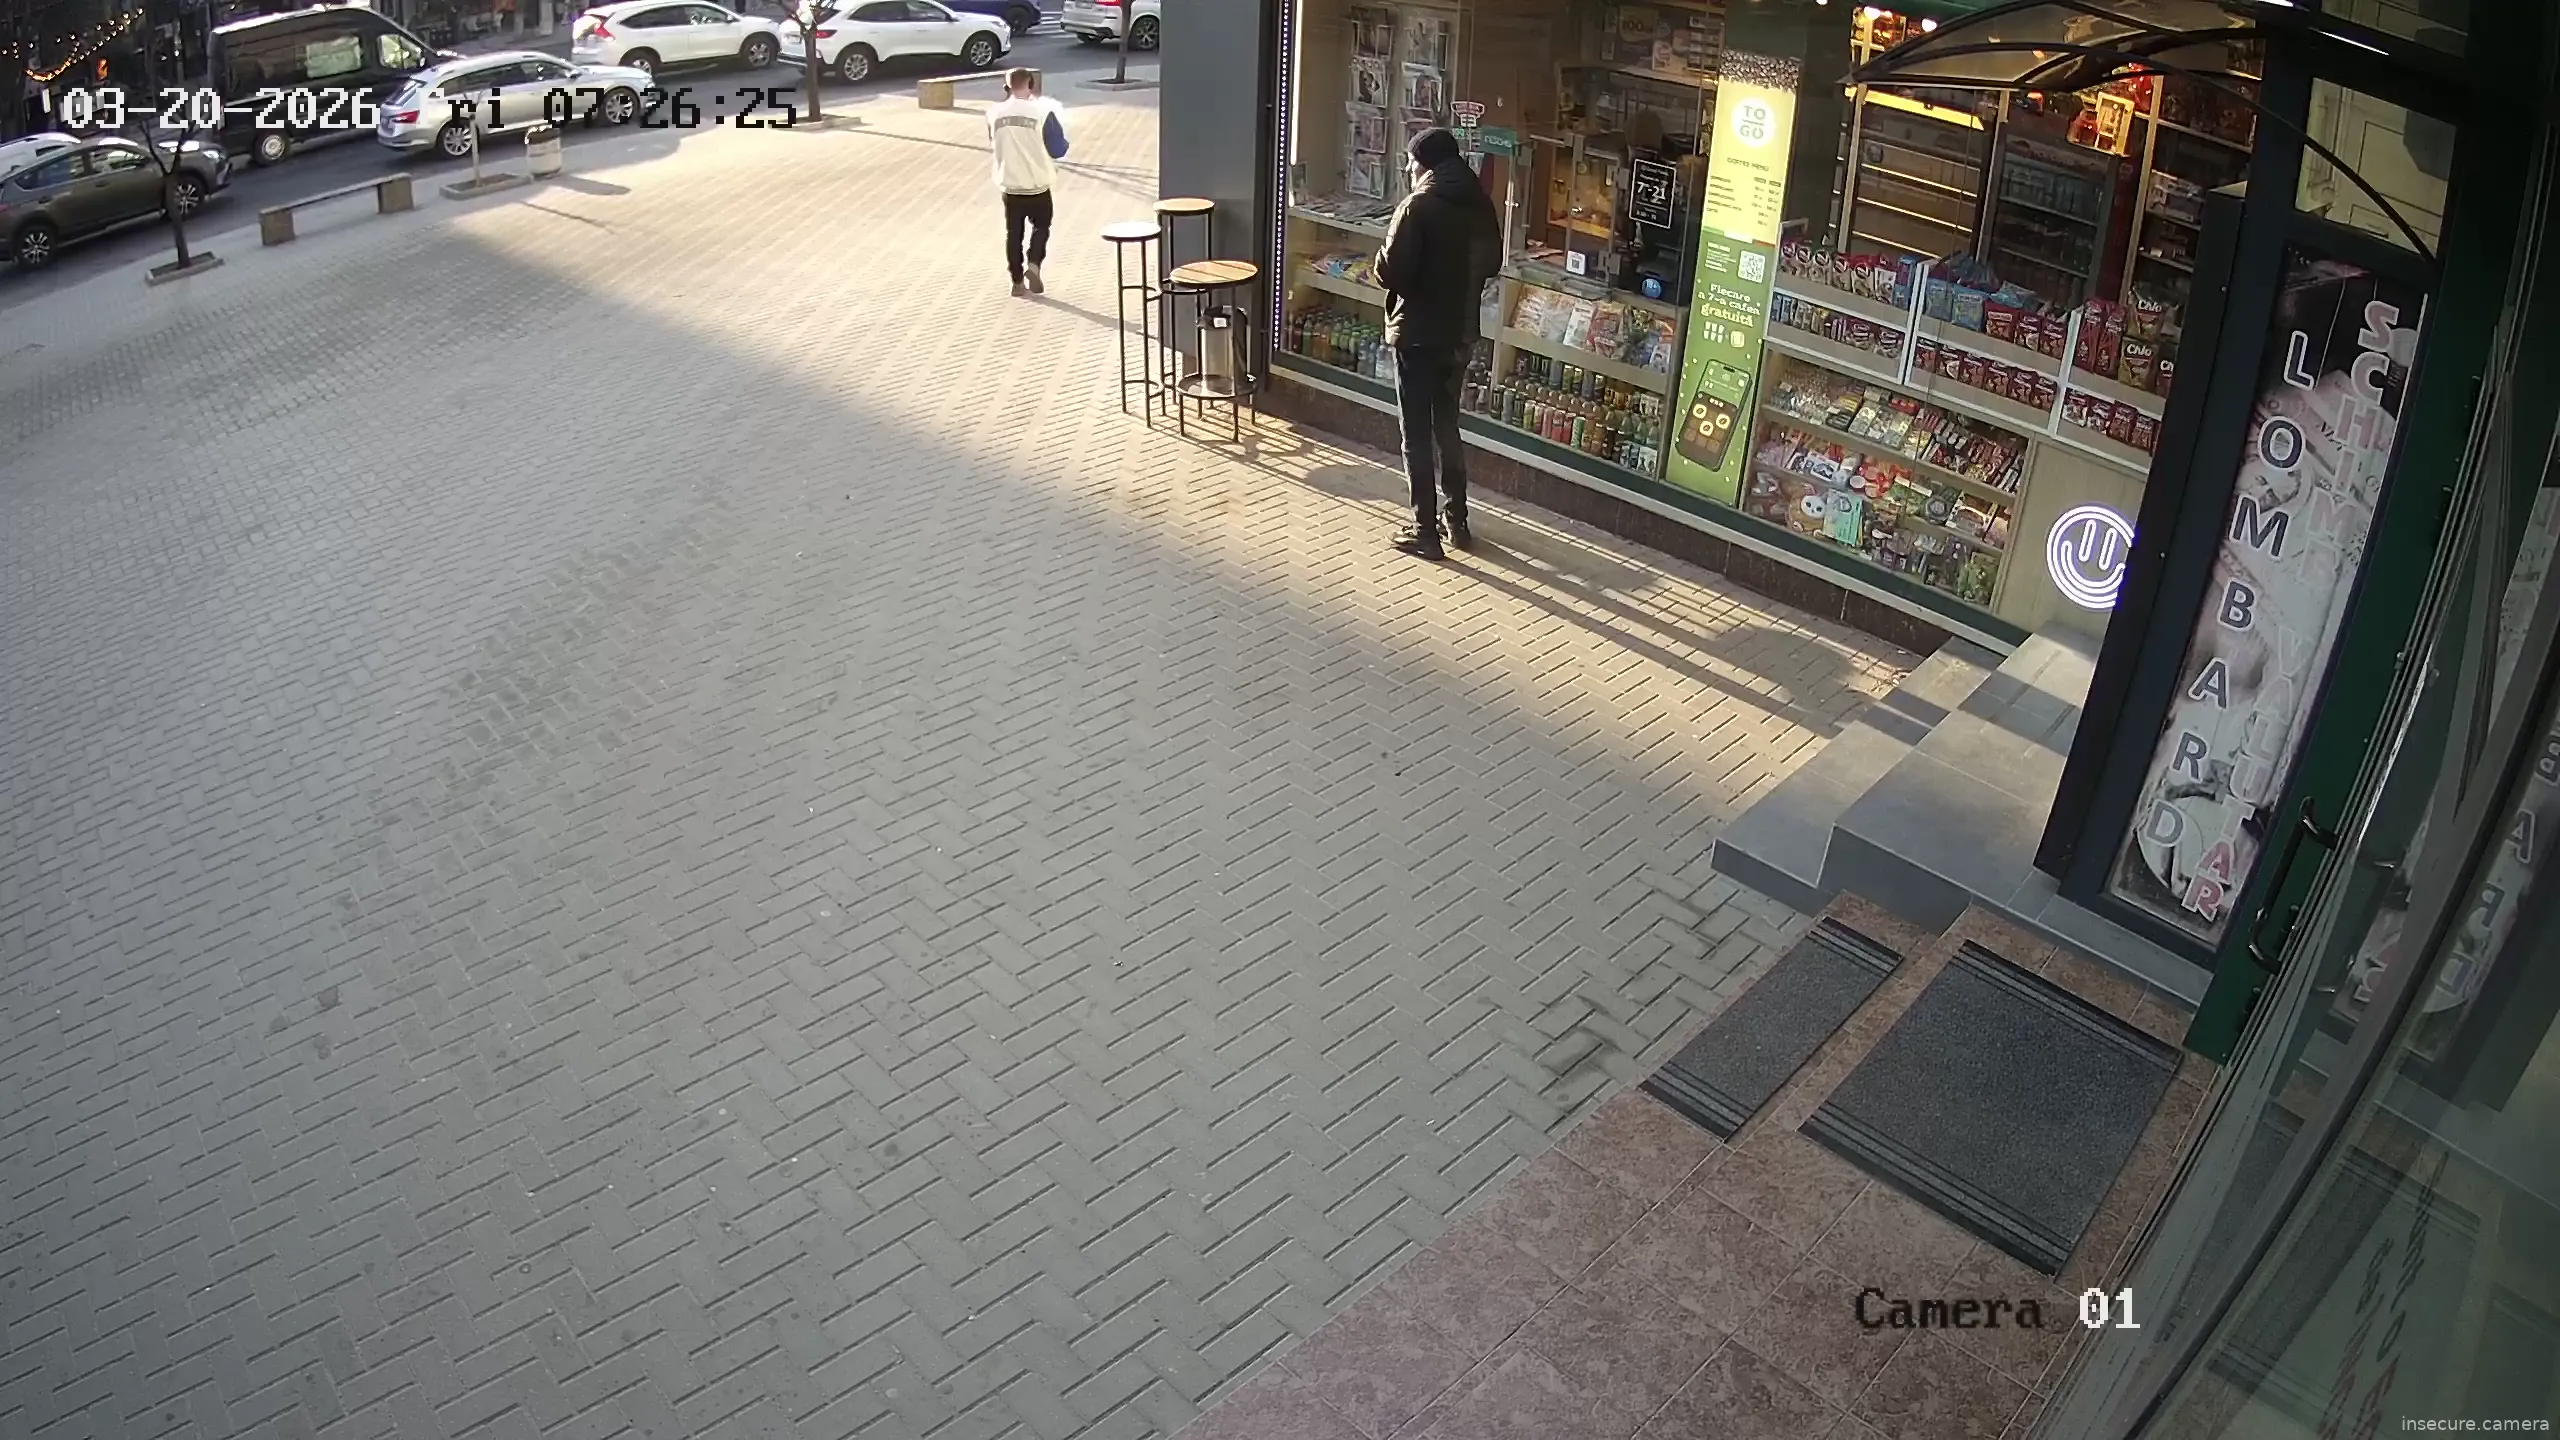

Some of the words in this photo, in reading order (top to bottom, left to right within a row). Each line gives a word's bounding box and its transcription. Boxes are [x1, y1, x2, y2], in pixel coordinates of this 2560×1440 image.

[1743, 105, 1766, 120] TO
[1740, 125, 1764, 139] GO
[1710, 283, 1751, 303] Fiecare
[1697, 291, 1706, 300] a
[1729, 301, 1760, 316] cafea
[2138, 299, 2162, 313] Chio
[2127, 343, 2152, 357] Chio
[2146, 329, 2315, 848] LOMBARD
[2180, 626, 2316, 923] VALUTAR
